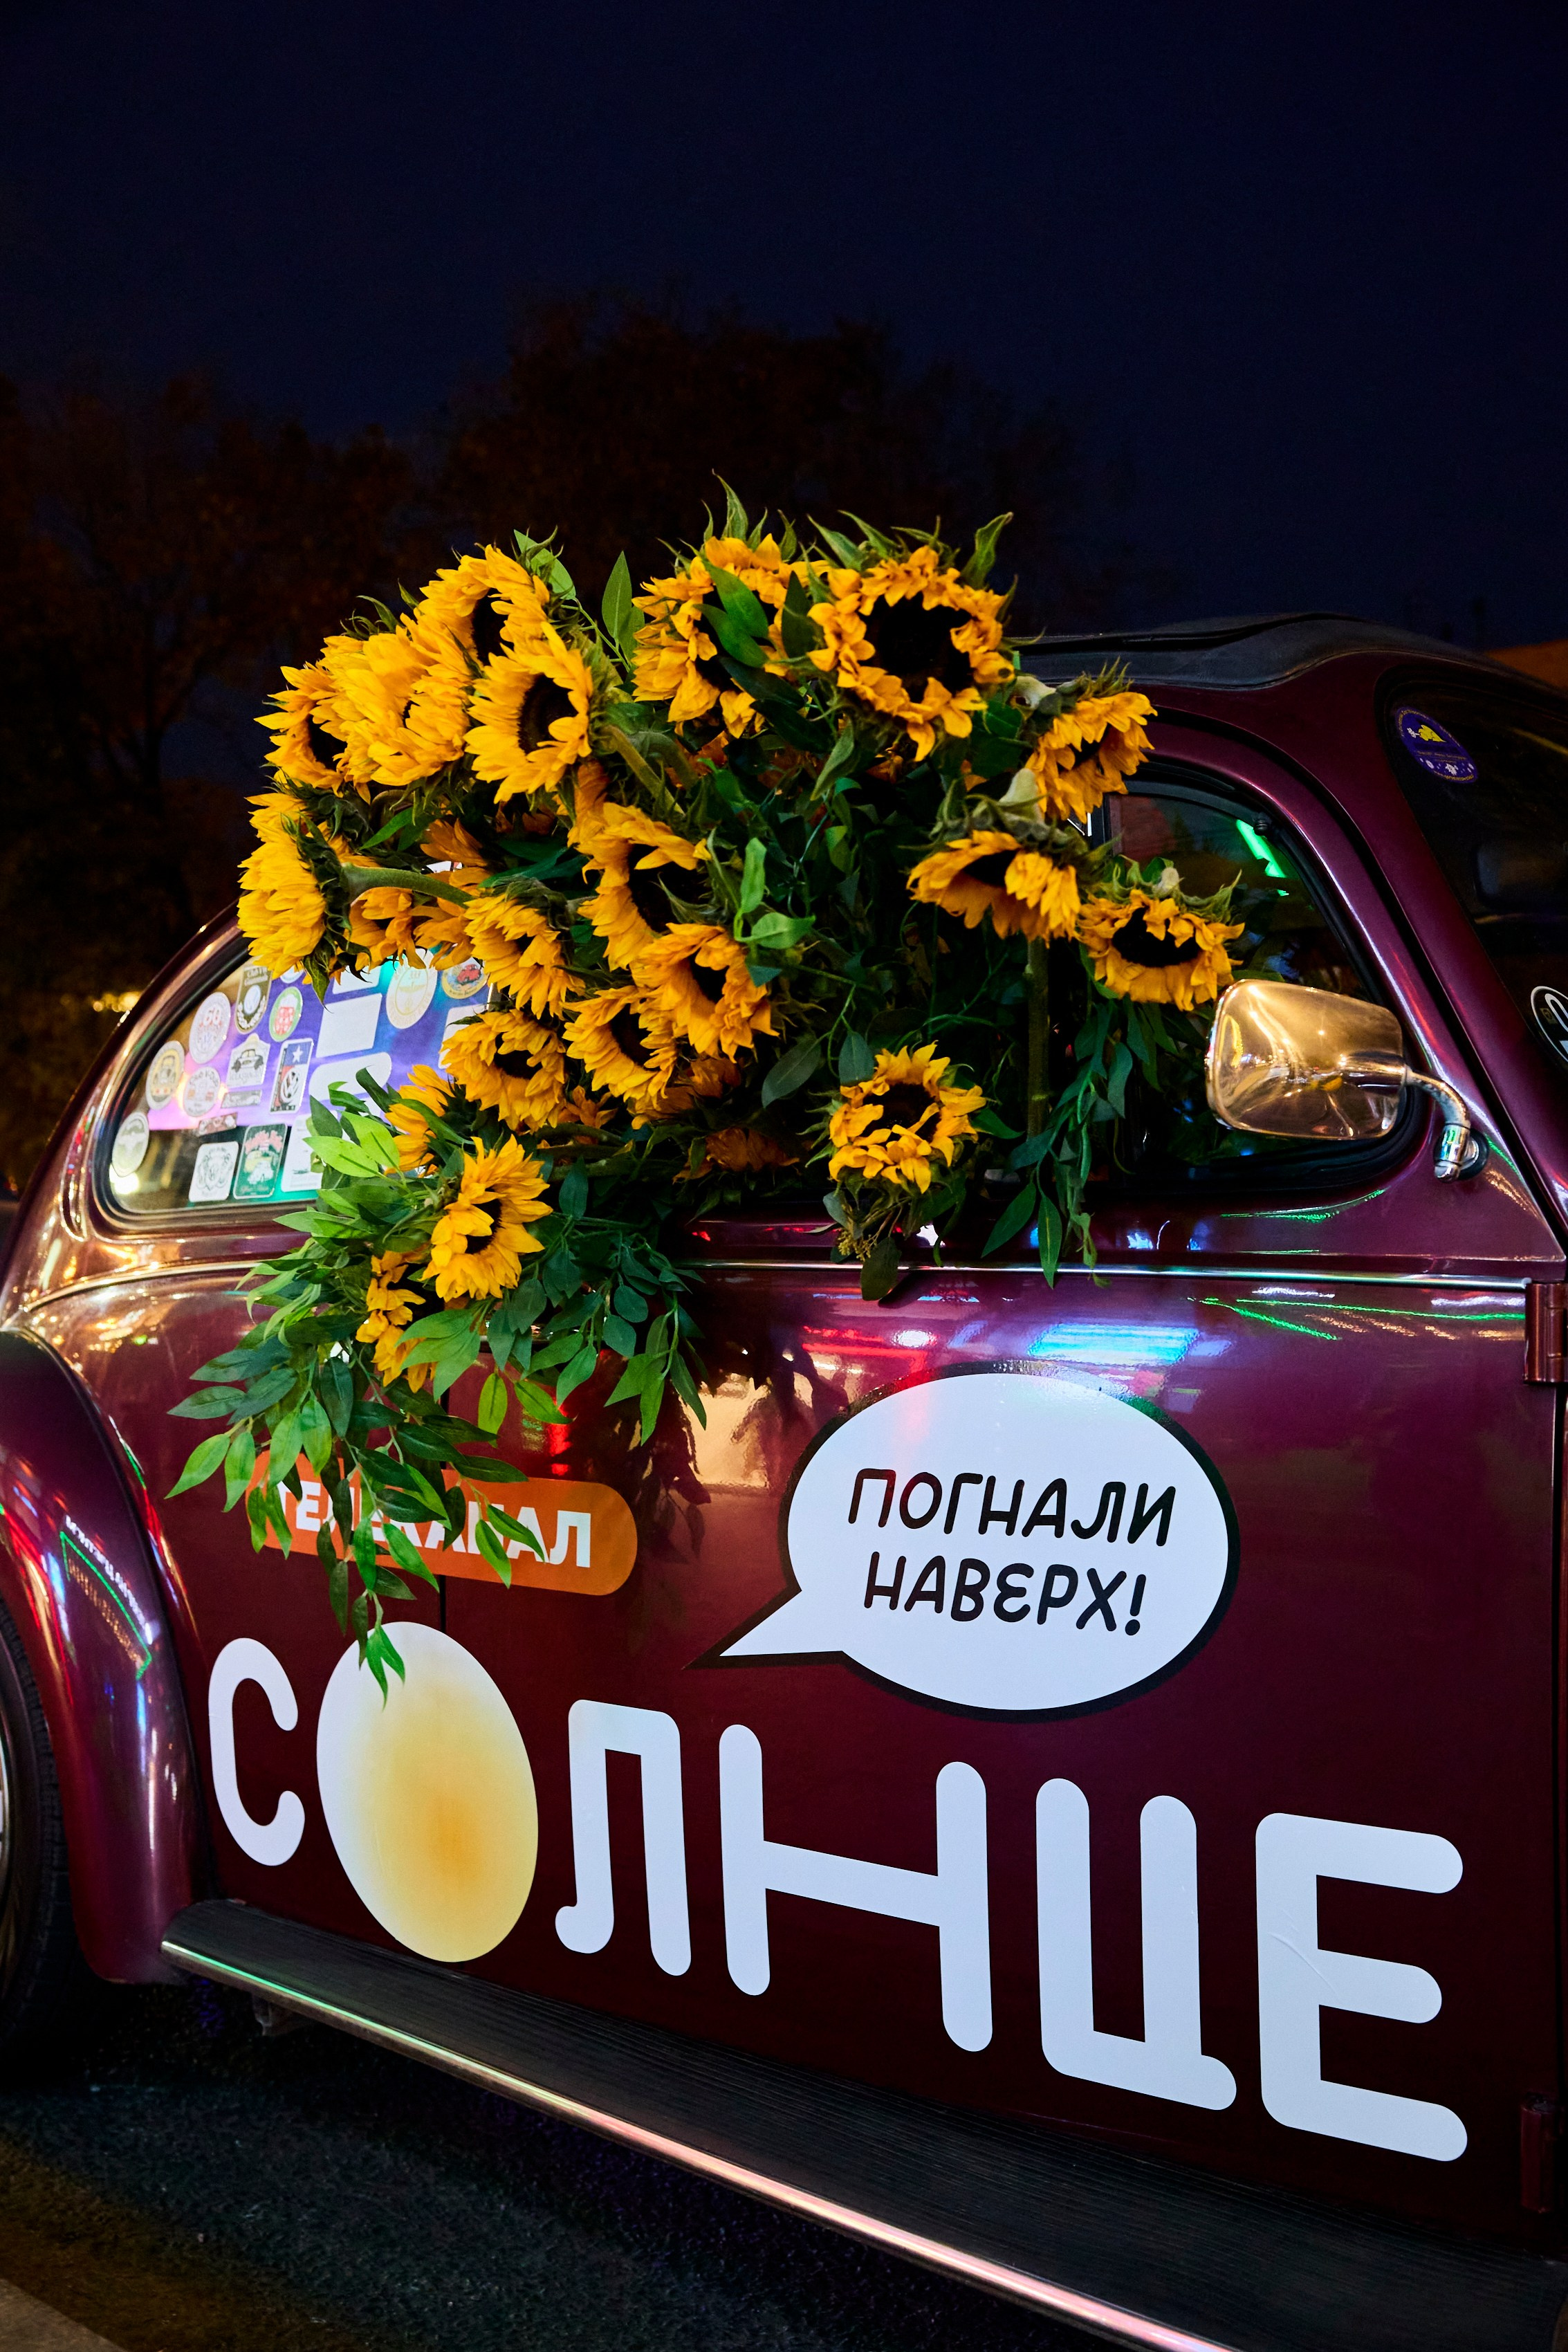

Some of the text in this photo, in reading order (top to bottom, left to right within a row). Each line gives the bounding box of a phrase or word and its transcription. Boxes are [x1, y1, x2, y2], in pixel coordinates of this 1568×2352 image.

[274, 1479, 591, 1568] ЕАНАЛ
[848, 1468, 1177, 1547] ПОГНАЛИ
[863, 1552, 1147, 1636] НАВЕРХ!
[208, 1621, 1468, 2163] СОЛНЦЕ
